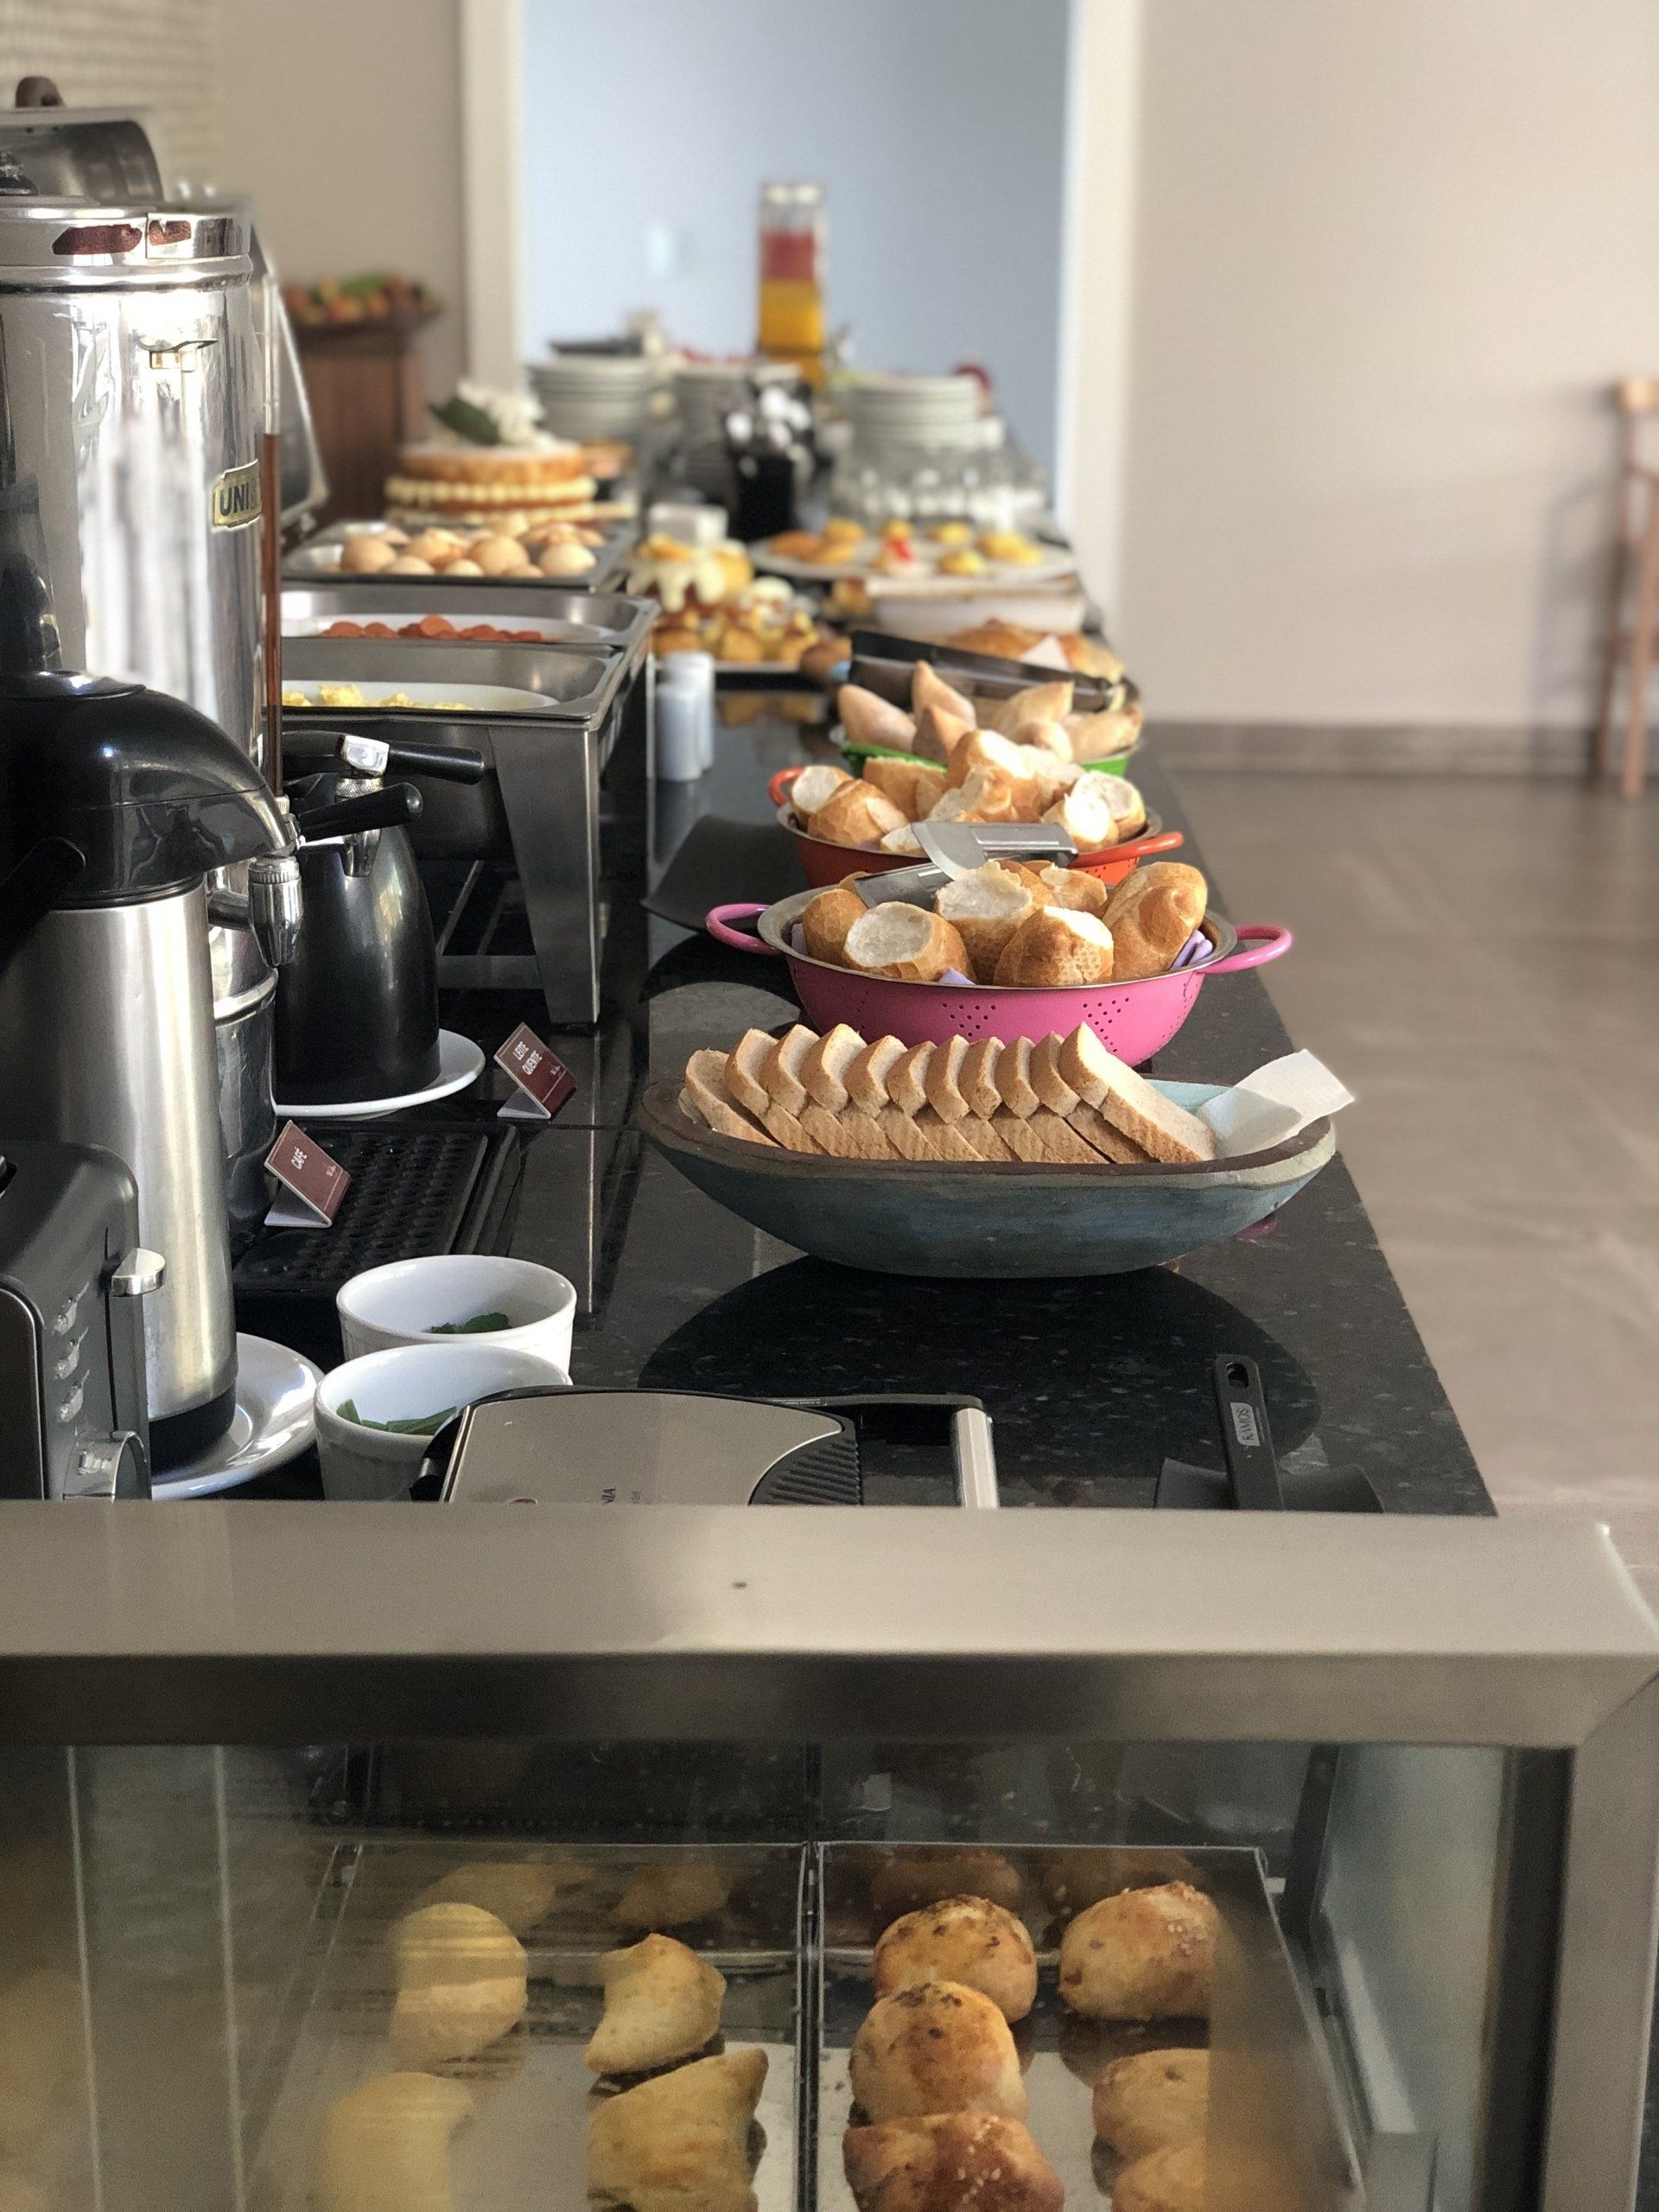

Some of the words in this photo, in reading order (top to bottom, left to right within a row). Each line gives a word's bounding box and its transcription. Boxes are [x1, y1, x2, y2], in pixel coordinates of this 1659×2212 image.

[512, 1041, 529, 1061] LEITE
[522, 1050, 543, 1075] QUENTE
[291, 1146, 308, 1170] CAFÉ
